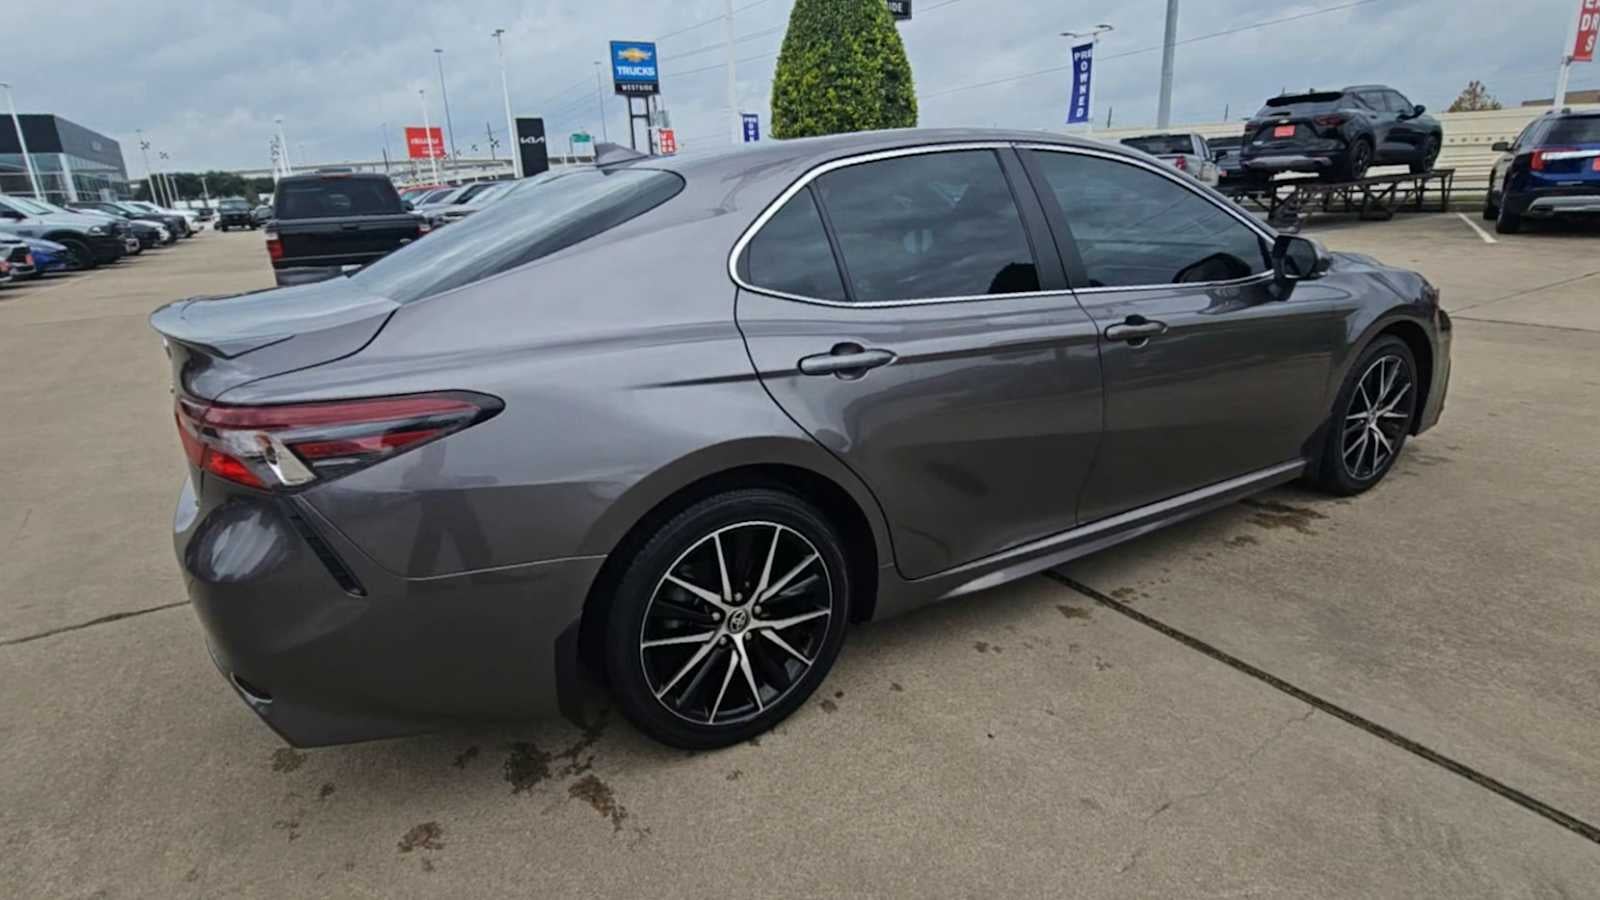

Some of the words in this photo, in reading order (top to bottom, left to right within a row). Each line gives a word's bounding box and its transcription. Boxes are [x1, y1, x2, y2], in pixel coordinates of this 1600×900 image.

[1074, 48, 1092, 61] PRE
[616, 66, 656, 76] TRUCKS
[621, 84, 654, 92] WESTSIDE
[1076, 60, 1089, 118] OWNED
[520, 135, 545, 144] KIA
